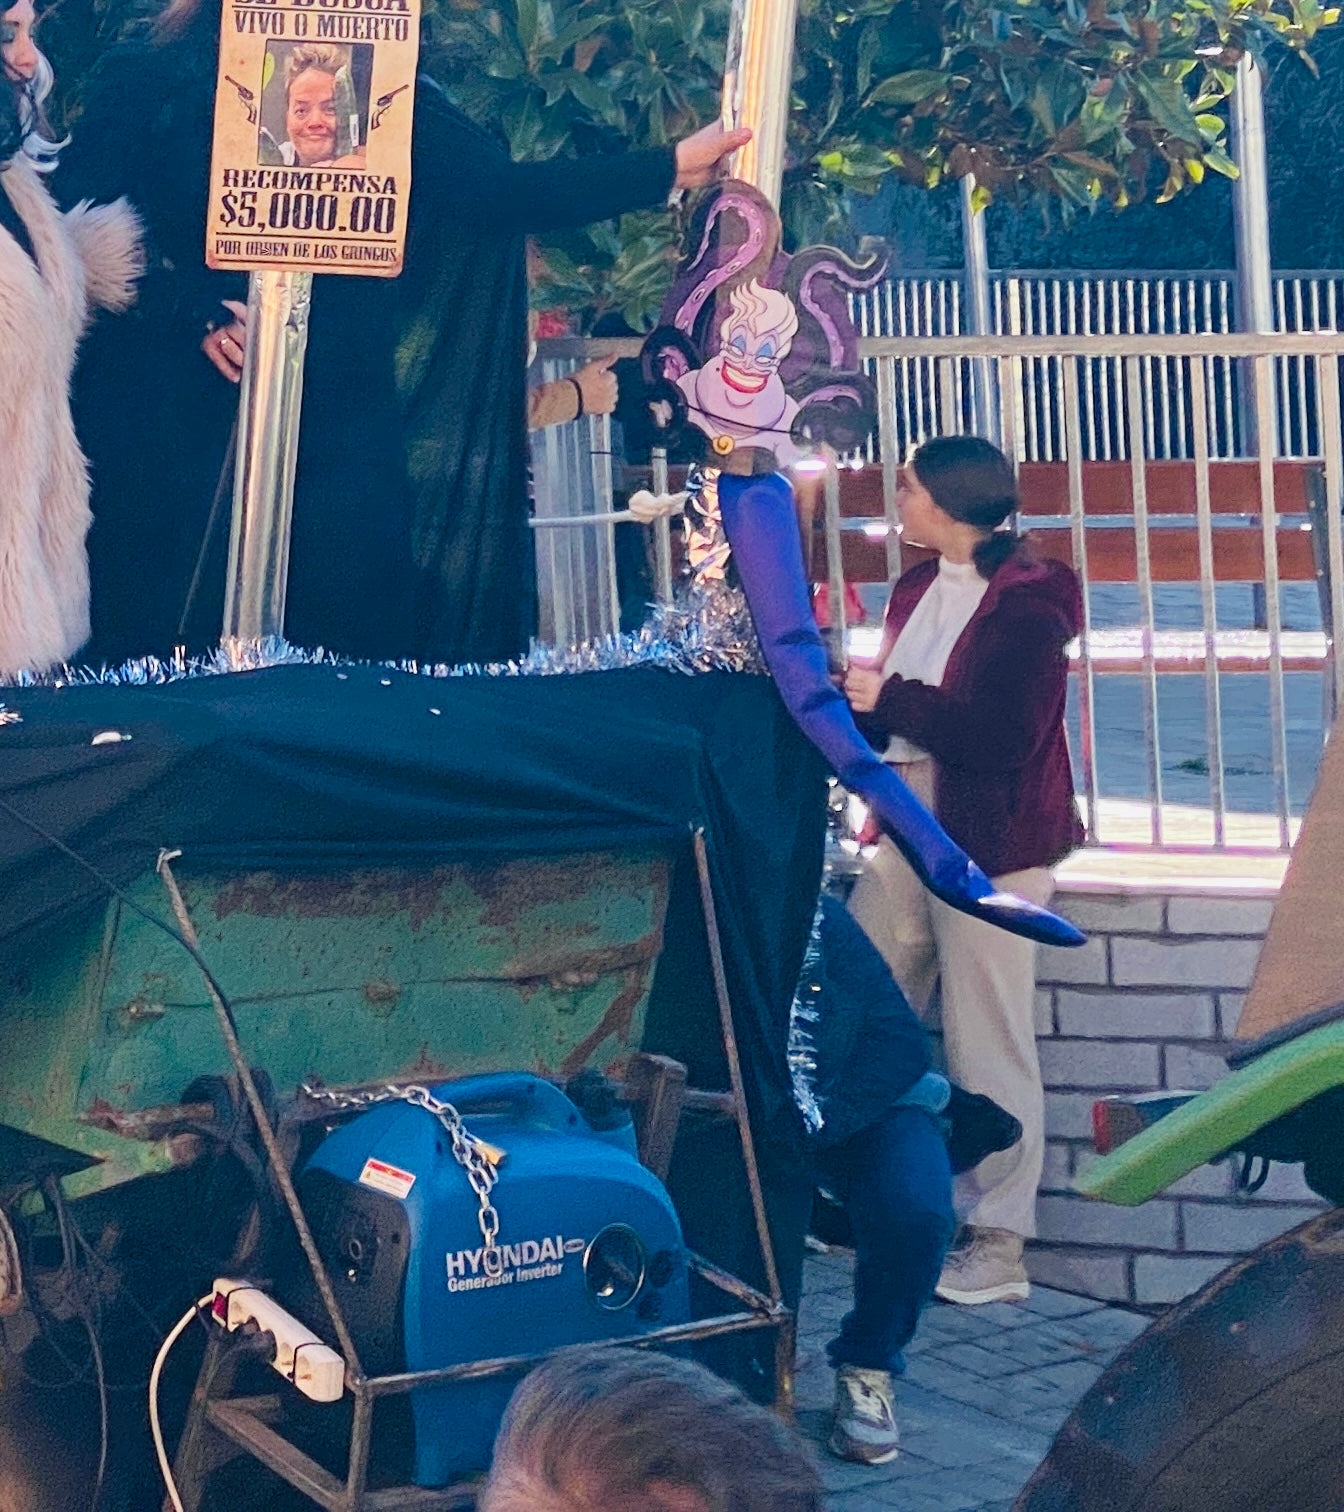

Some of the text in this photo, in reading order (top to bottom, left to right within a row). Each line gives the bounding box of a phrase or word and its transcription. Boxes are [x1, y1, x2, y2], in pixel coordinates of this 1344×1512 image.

[233, 9, 409, 41] VIVO O MUERTO
[222, 168, 398, 195] RECOMPENSA
[219, 189, 397, 234] $5,000.00
[215, 239, 242, 256] POR
[293, 243, 310, 258] DE
[314, 244, 338, 260] LOS
[341, 246, 398, 263] GRINGOS
[516, 1262, 564, 1282] Inverter
